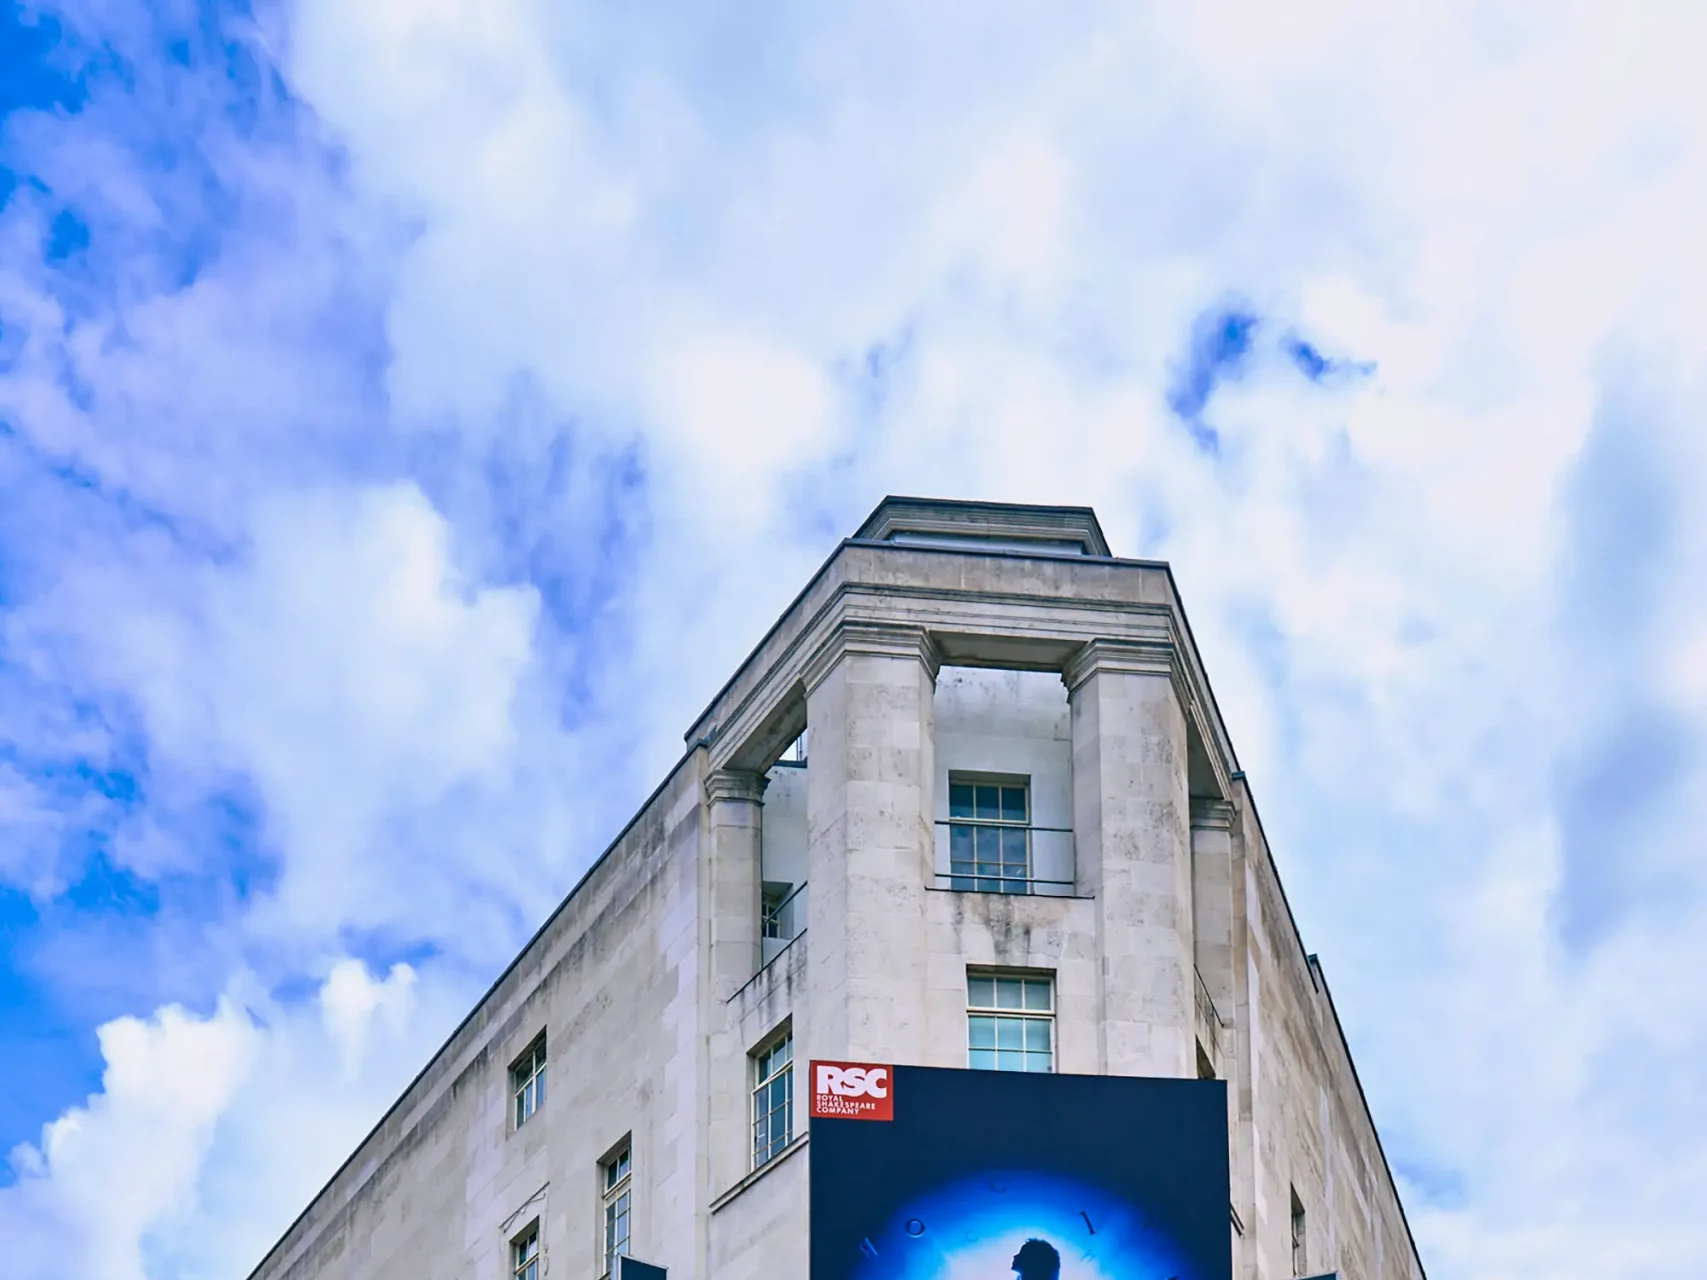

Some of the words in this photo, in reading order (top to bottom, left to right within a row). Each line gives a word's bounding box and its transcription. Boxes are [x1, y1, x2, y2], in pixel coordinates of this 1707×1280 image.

[816, 1065, 887, 1098] RSC
[817, 1101, 876, 1110] SHAKESPEARE
[816, 1106, 860, 1115] COMPANY
